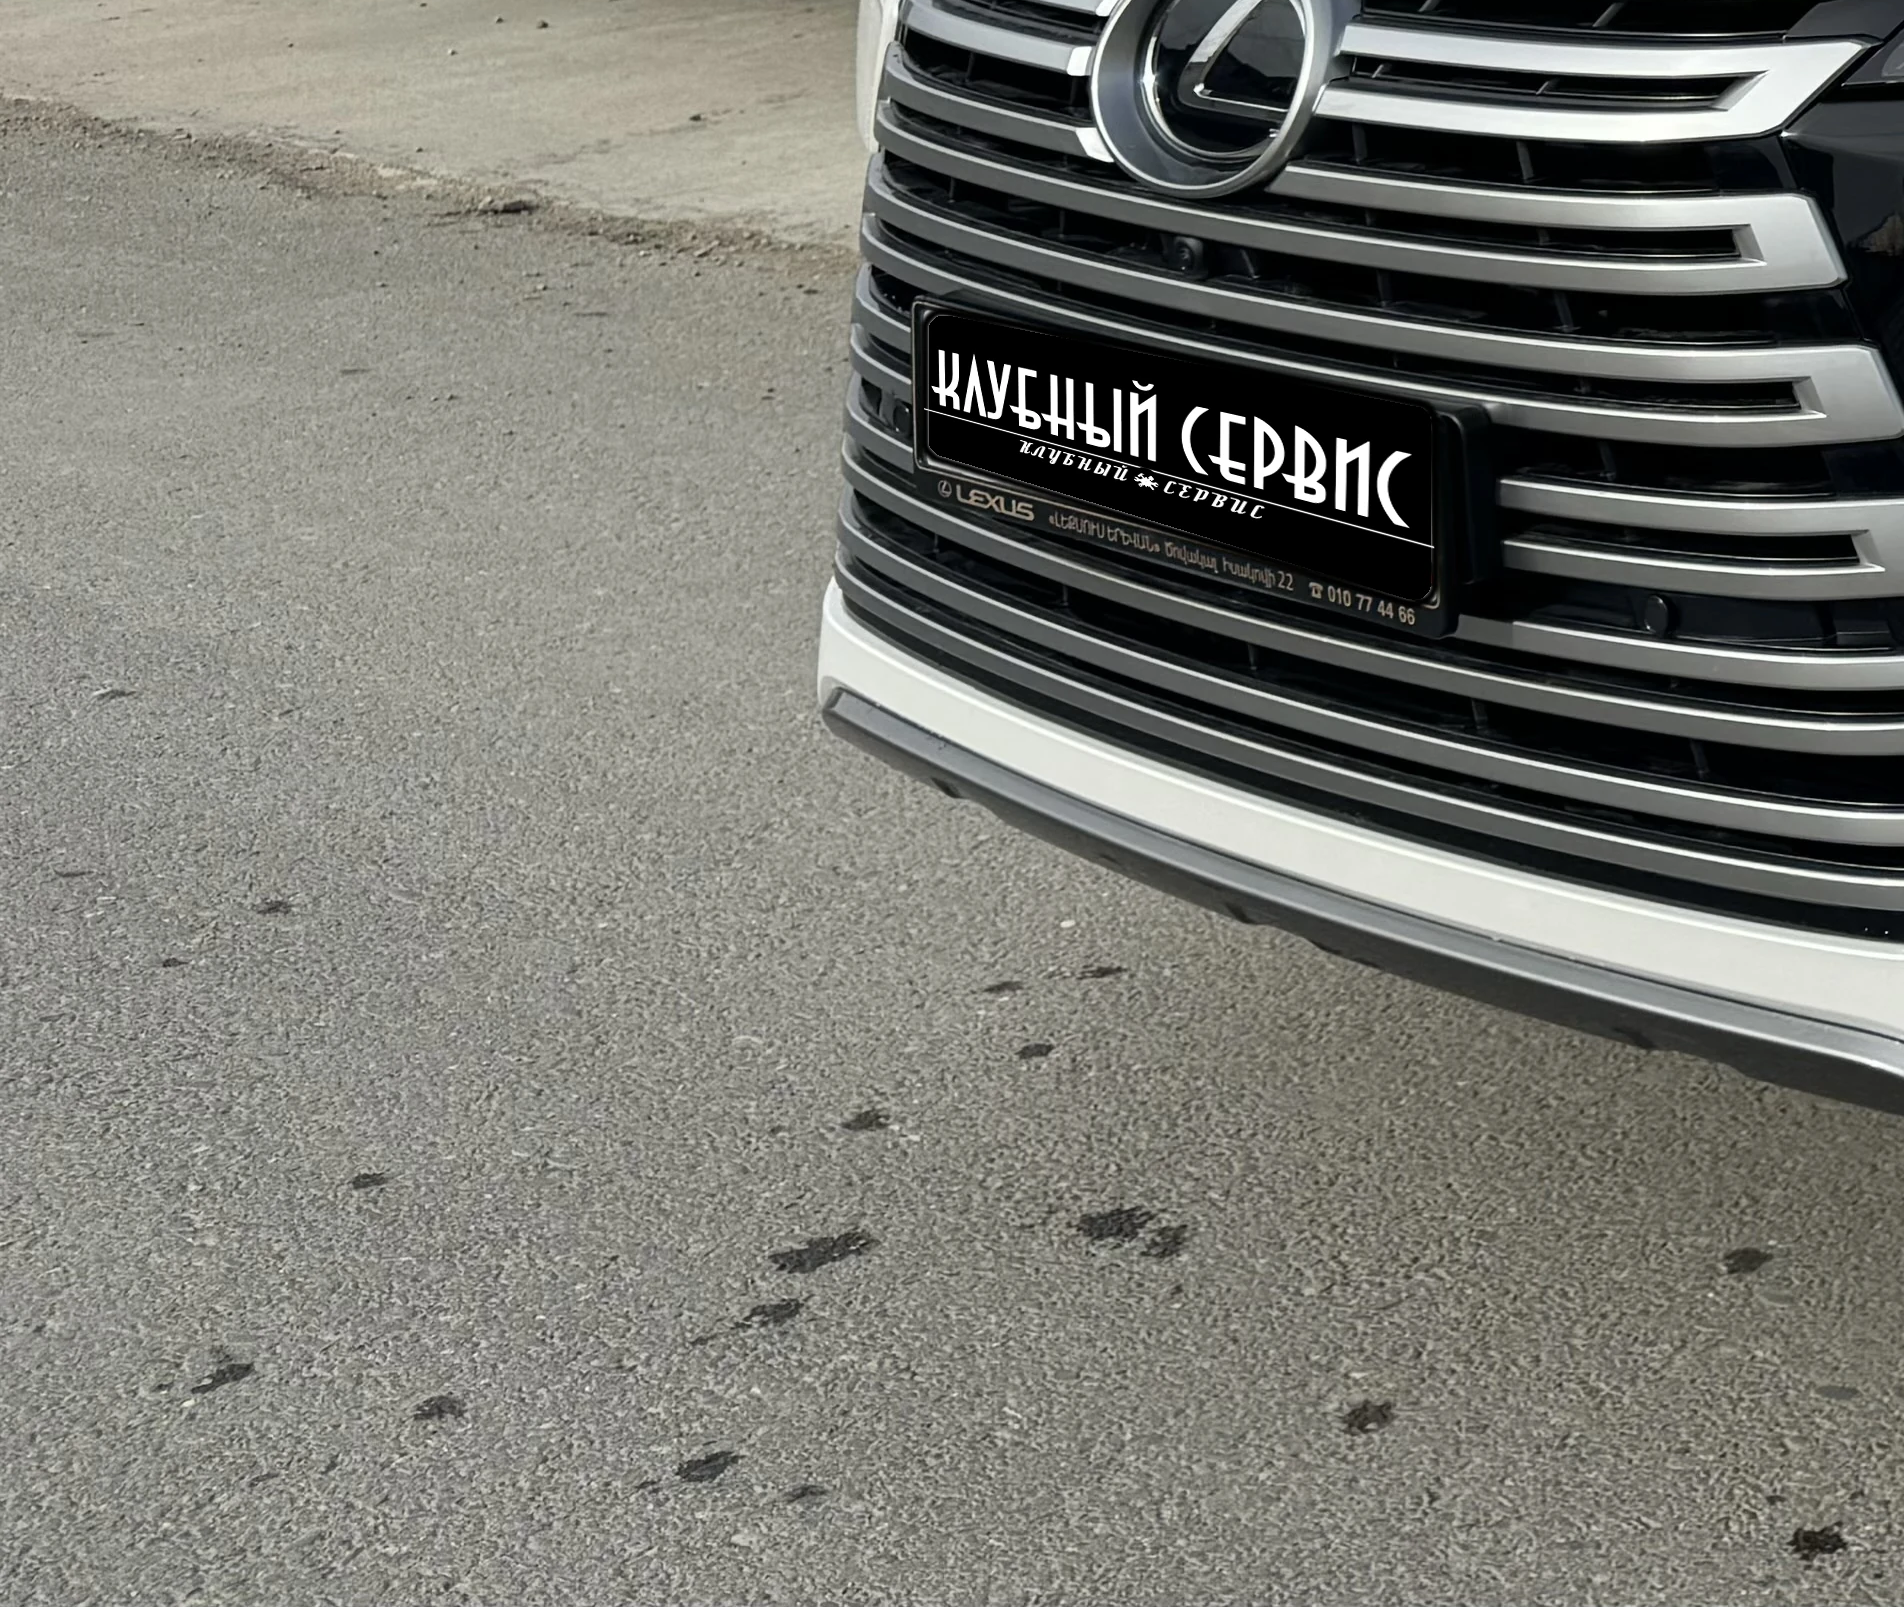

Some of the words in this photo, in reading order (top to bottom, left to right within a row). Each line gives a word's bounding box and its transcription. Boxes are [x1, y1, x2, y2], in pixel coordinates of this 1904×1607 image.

[955, 484, 1035, 522] LEXUS
[1277, 570, 1294, 591] 22
[1327, 585, 1352, 607] 010
[1356, 593, 1373, 612] 77
[1377, 600, 1394, 619] 44
[1398, 605, 1416, 626] 66
